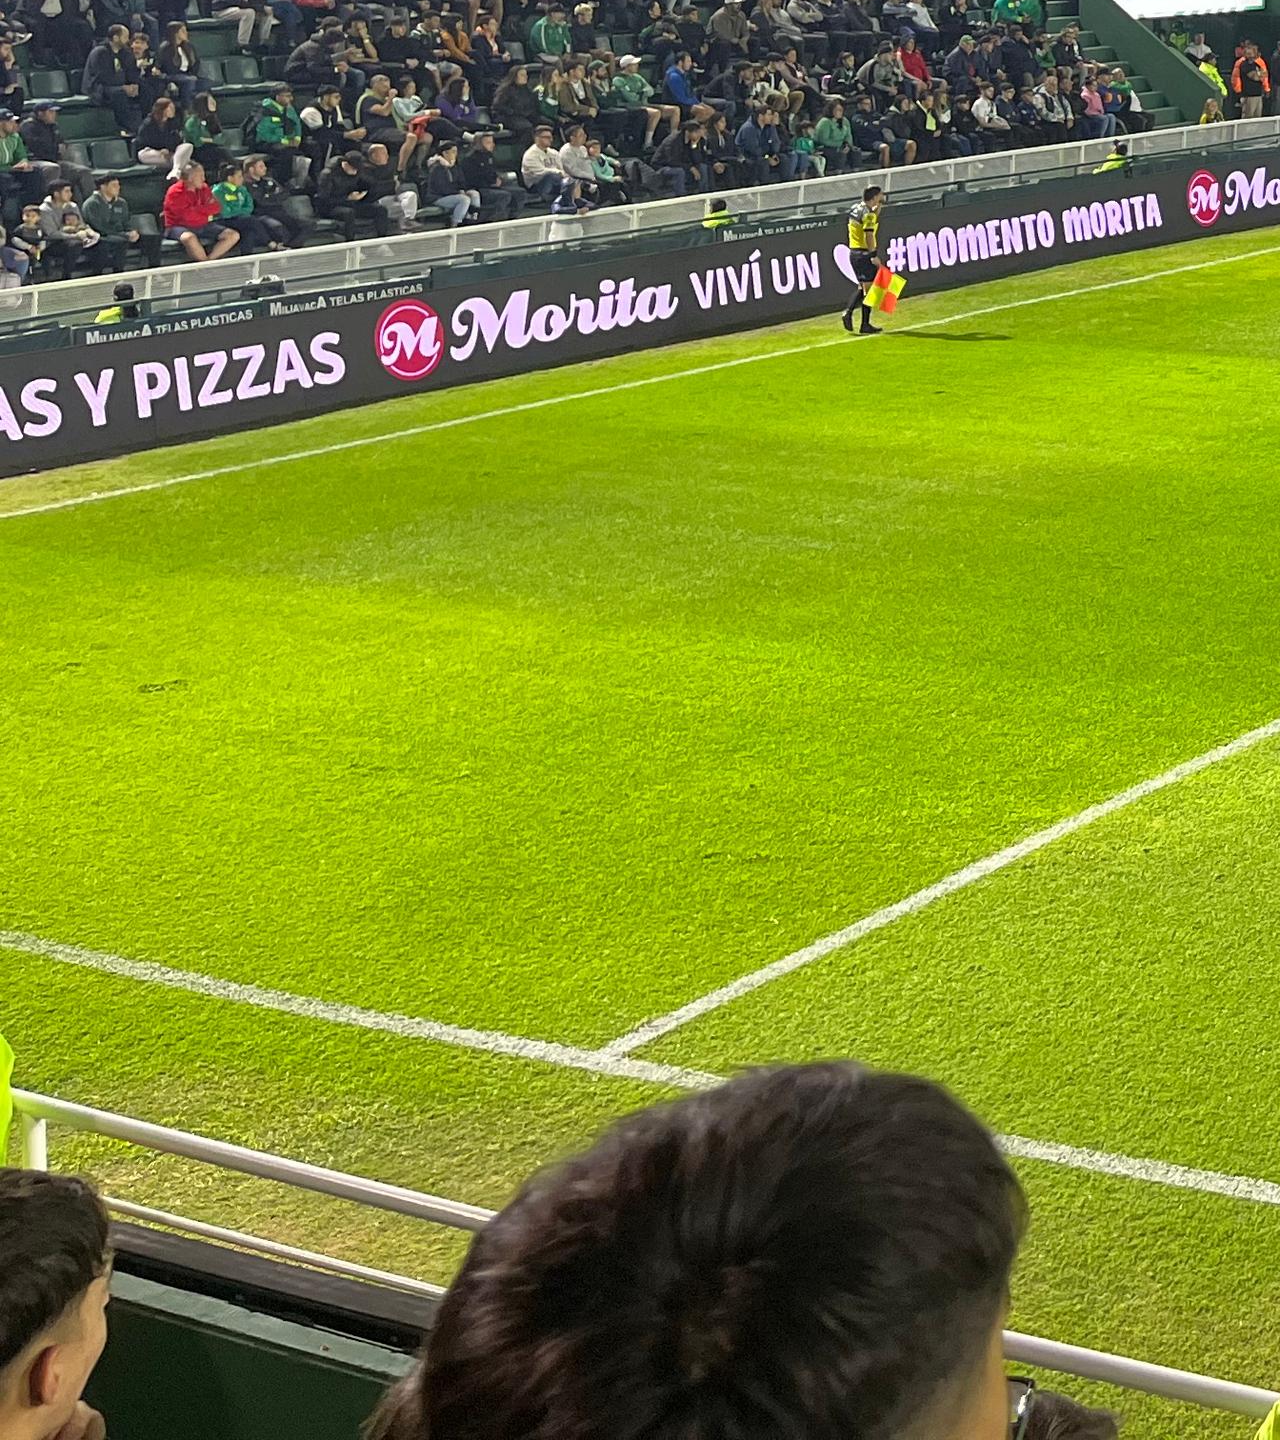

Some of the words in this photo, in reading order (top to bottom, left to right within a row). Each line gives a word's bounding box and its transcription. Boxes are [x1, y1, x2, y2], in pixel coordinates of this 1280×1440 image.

[329, 291, 365, 308] TELAS
[367, 283, 423, 302] PLASTICAS
[190, 309, 254, 330] PLASTICAS
[74, 368, 114, 427] Y
[133, 331, 346, 419] PIZZAS
[449, 276, 680, 362] Morita
[689, 248, 763, 311] VIVÍ
[770, 251, 822, 297] UN
